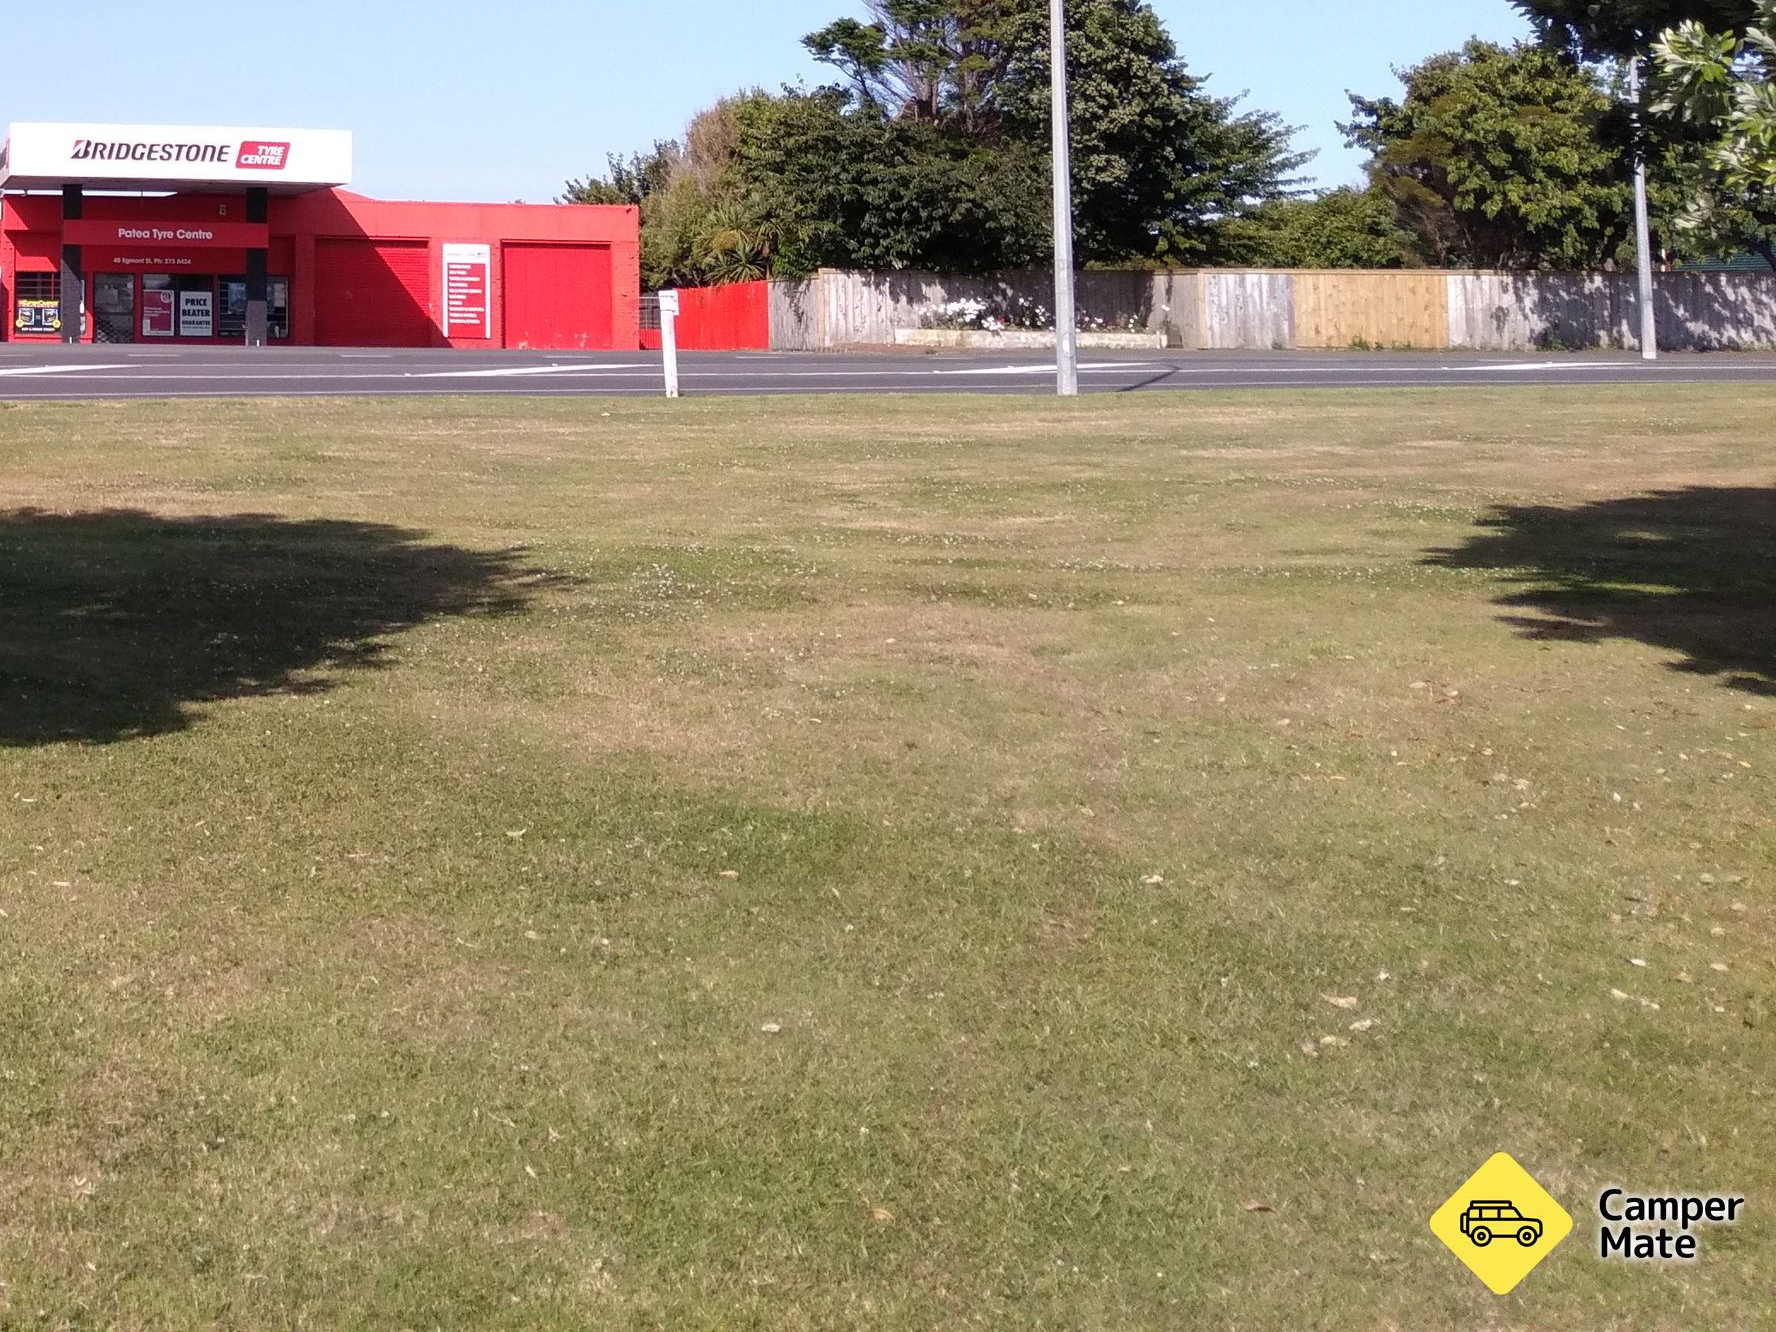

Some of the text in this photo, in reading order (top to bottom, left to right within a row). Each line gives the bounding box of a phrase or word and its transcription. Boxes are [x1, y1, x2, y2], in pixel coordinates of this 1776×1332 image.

[70, 139, 231, 163] BRIDGESTONE
[257, 145, 285, 156] TYRE
[240, 154, 282, 166] CENTRE
[118, 228, 213, 240] Patea Tyre Centre
[185, 298, 207, 306] PRICE
[182, 309, 210, 317] BEATER
